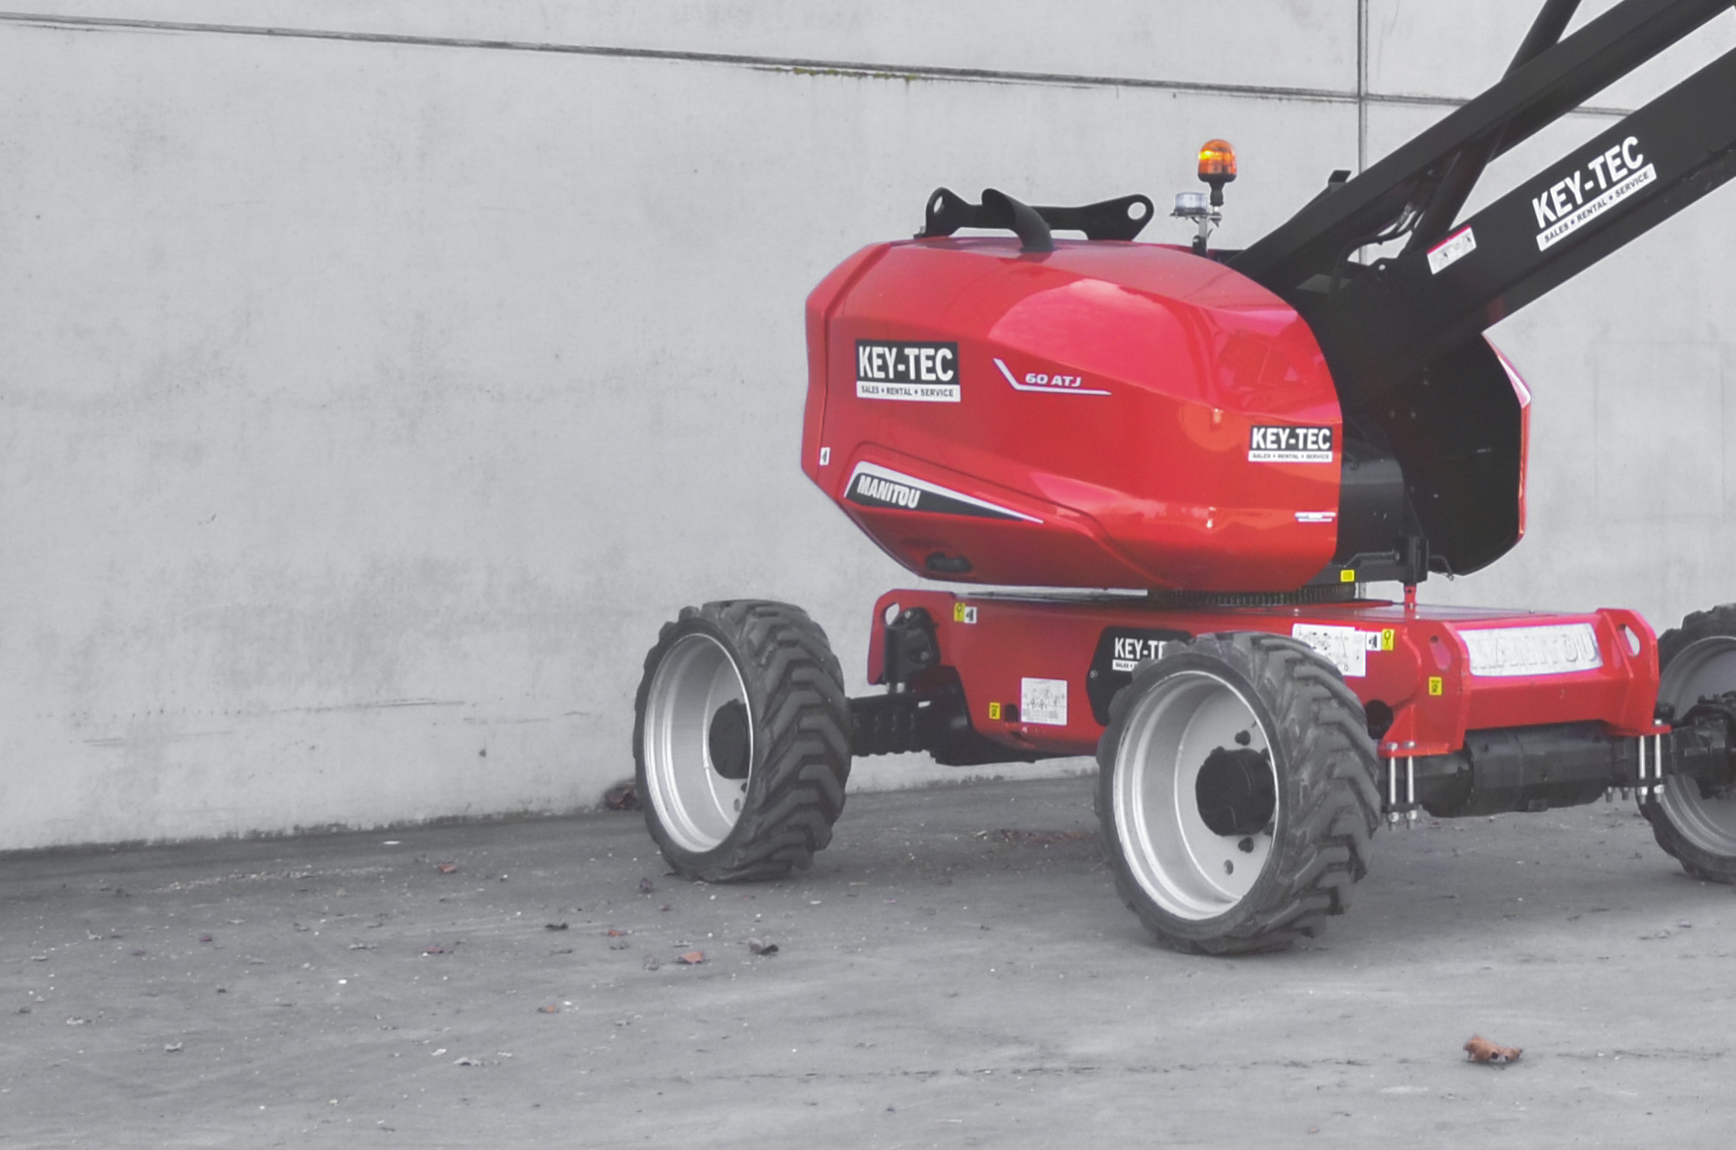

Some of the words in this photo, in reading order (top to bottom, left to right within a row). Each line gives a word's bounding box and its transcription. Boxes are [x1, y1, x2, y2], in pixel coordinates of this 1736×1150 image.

[1532, 136, 1644, 229] KEY-TEC
[1544, 223, 1569, 243] SALES
[1576, 199, 1607, 223] RENTAL
[1615, 171, 1649, 197] SERVICE
[859, 346, 954, 381] KEY-TEC
[861, 385, 879, 394] SALES
[886, 387, 912, 396] RENTAL
[921, 388, 954, 397] SERVICE
[1025, 373, 1048, 384] 60
[1051, 375, 1082, 387] ATJ
[1252, 427, 1331, 450] KEY-TEC
[857, 475, 921, 509] MANITOU
[1115, 637, 1168, 659] KEY-T
